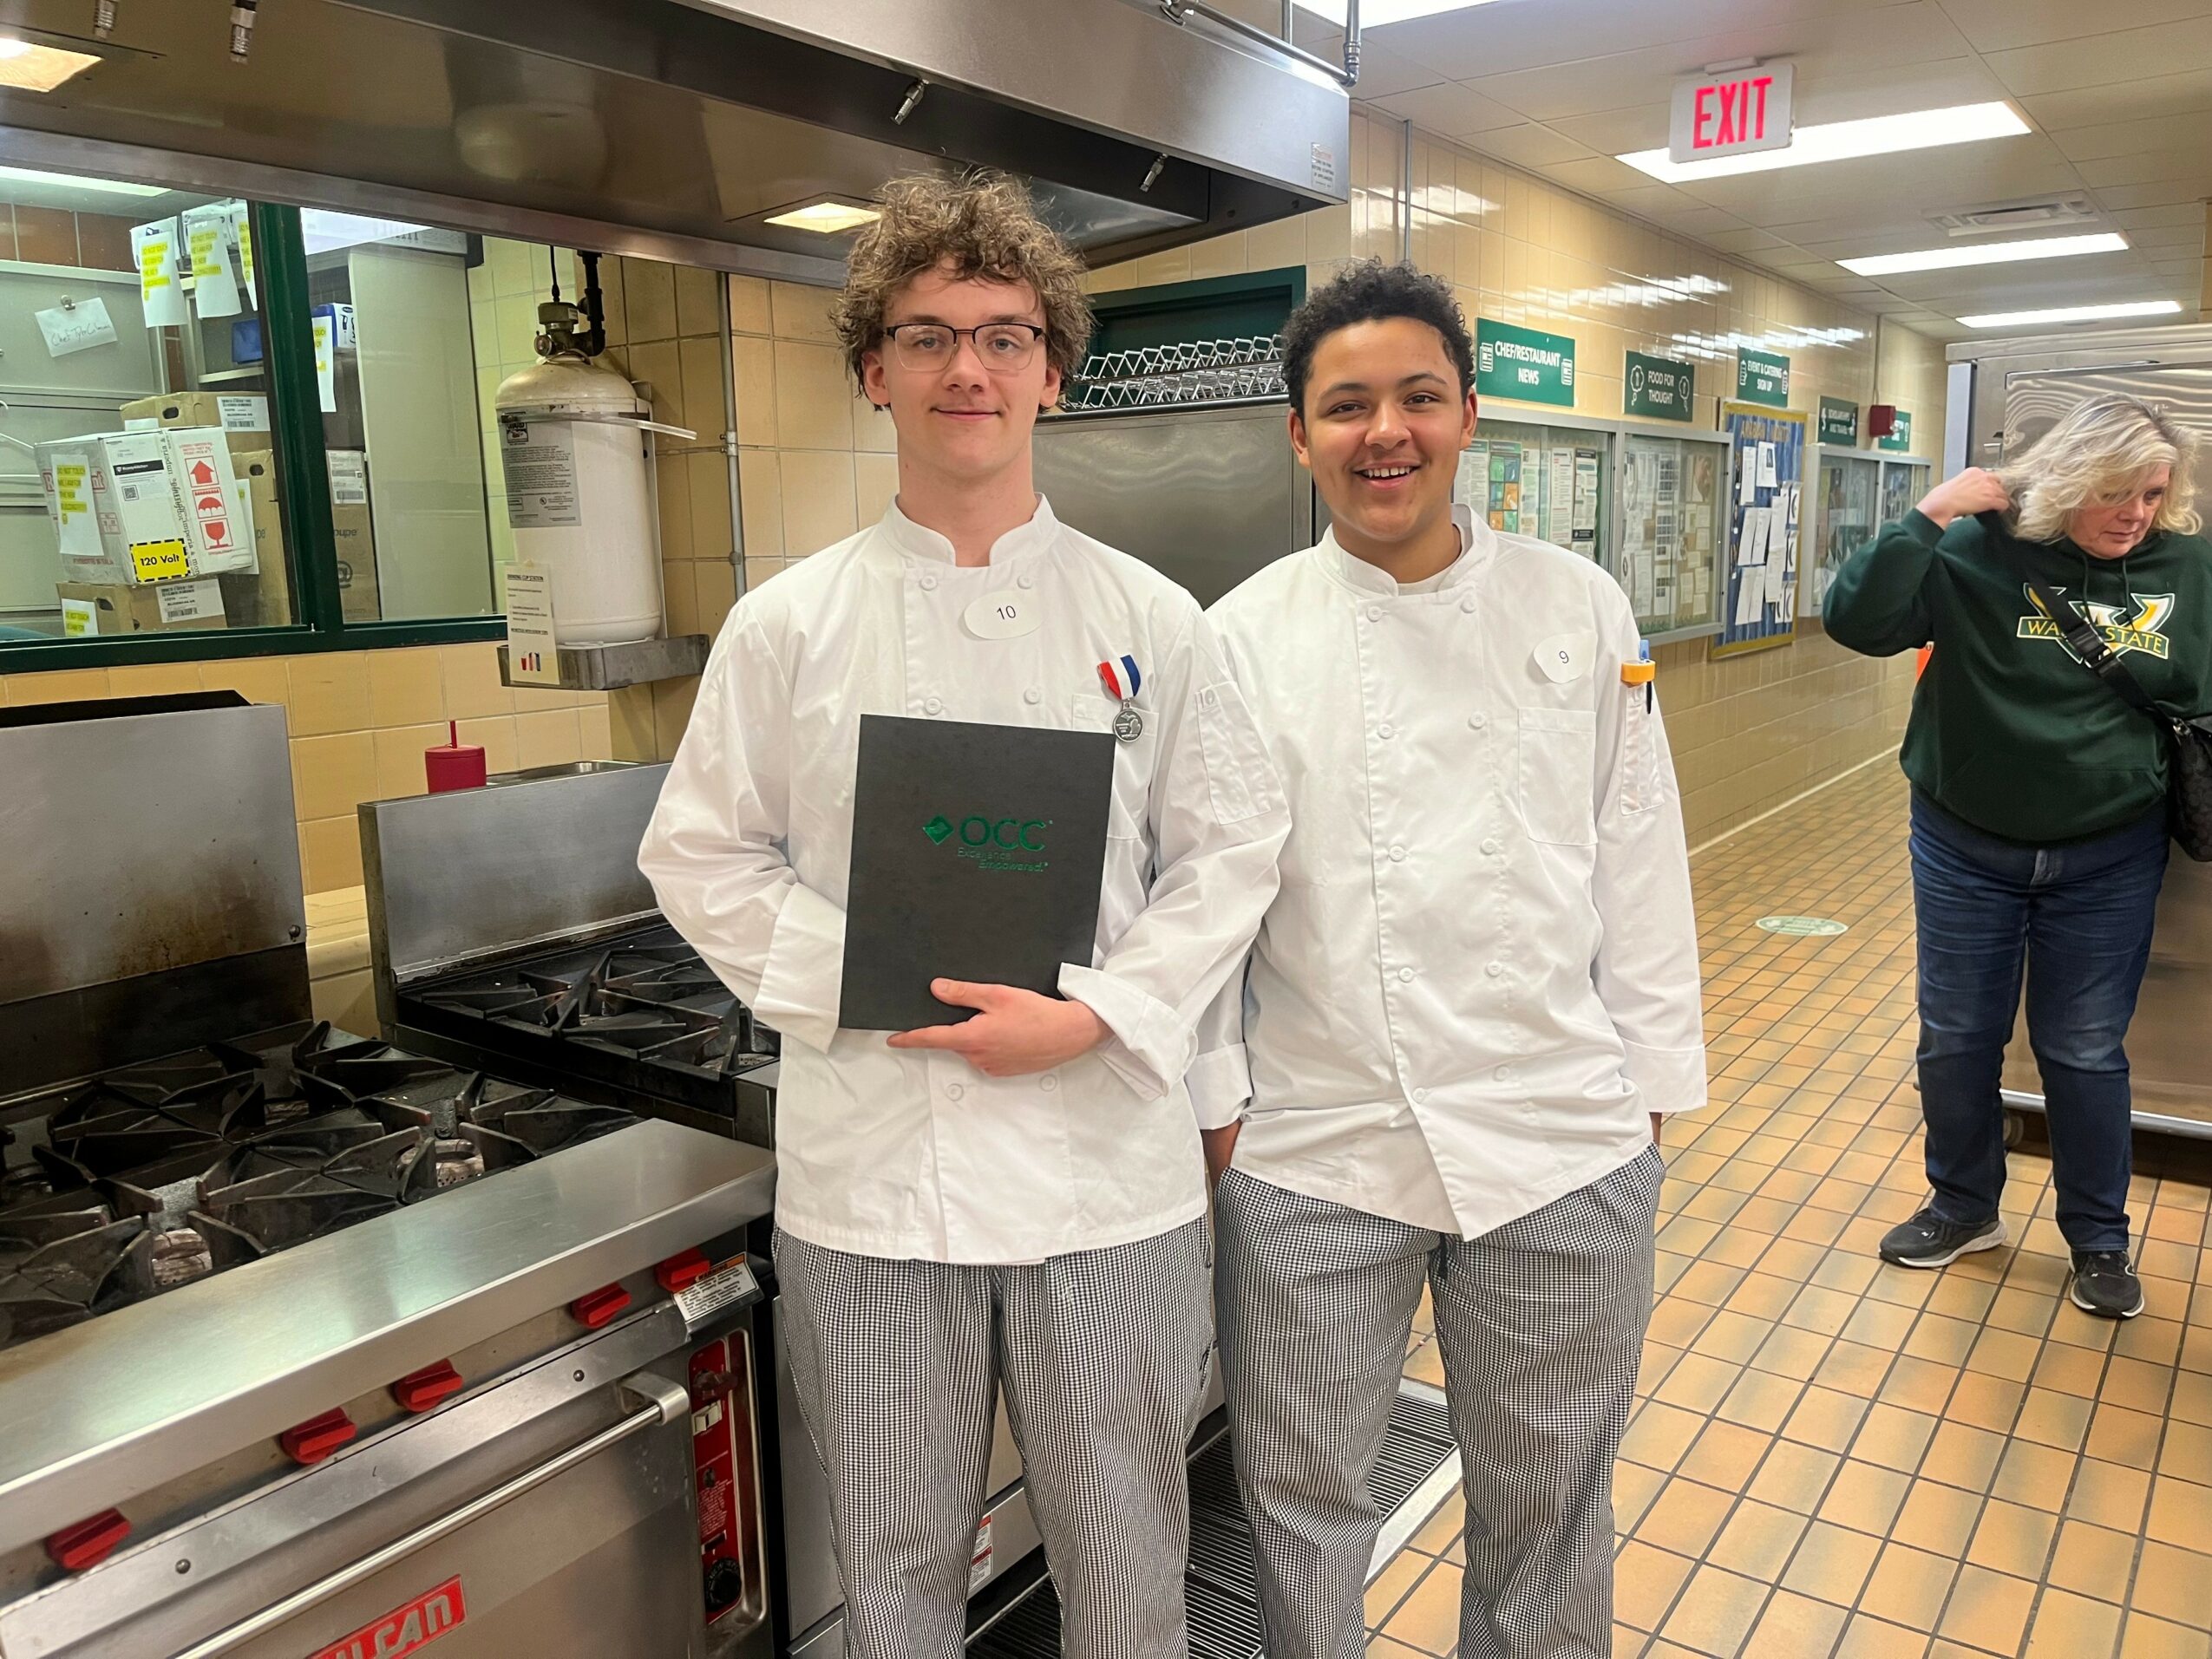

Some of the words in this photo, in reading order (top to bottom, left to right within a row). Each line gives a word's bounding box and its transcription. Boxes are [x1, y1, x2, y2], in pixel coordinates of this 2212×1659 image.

[1693, 76, 1773, 148] EXIT
[1495, 340, 1561, 367] CHEF/RESTAURANT
[1748, 360, 1760, 373] EVENT
[1518, 369, 1540, 385] NEWS
[1648, 370, 1664, 385] FOOD
[1664, 372, 1675, 387] FOR
[1648, 389, 1673, 405] THOUGHT
[141, 557, 157, 566] 120
[160, 554, 180, 564] Volt
[997, 605, 1017, 620] 10
[2105, 627, 2162, 654] STATE
[1559, 650, 1569, 663] 9
[960, 817, 1045, 851] OCC
